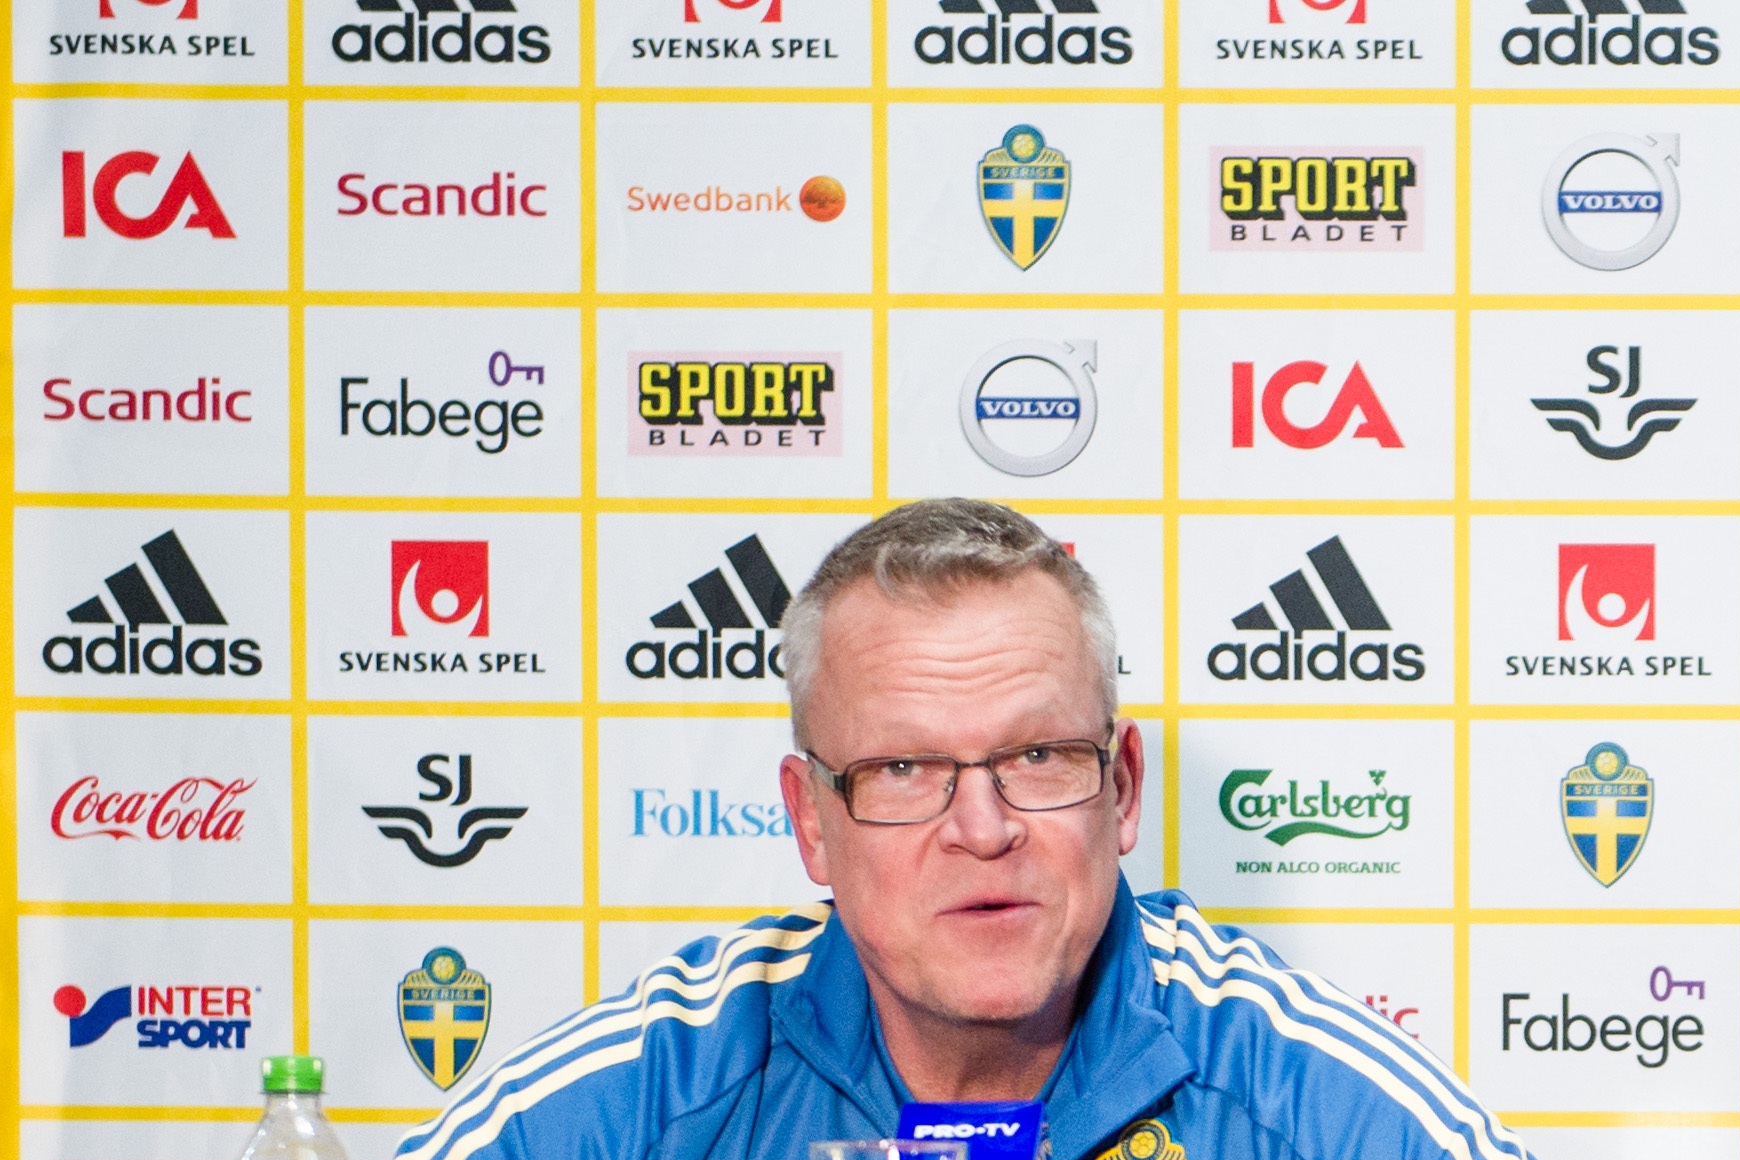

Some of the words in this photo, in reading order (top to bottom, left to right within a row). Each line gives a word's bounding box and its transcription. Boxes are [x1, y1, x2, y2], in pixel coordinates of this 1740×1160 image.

[50, 34, 176, 55] SVENSKA
[188, 36, 254, 56] SPEL
[331, 13, 551, 63] adidas
[633, 38, 760, 58] SVENSKA
[772, 38, 837, 58] SPEL
[914, 15, 1133, 65] adidas
[1217, 39, 1344, 59] SVENSKA
[1357, 39, 1422, 59] SPEL
[1501, 15, 1720, 66] adidas
[62, 151, 236, 239] ICA
[338, 172, 546, 216] Scandic
[628, 186, 791, 212] Swedbank
[1221, 155, 1417, 221] SPORT
[1563, 194, 1659, 210] VOLVO
[1231, 225, 1406, 242] BLADET
[638, 361, 835, 427] SPORT
[1587, 345, 1640, 398] SJ
[43, 378, 251, 422] Scandic
[341, 376, 544, 454] Fabege
[981, 400, 1076, 417] VOLVO
[1232, 361, 1404, 450] ICA
[649, 430, 824, 446] BLADET
[42, 625, 262, 676] adidas
[340, 652, 468, 672] SVENSKA
[479, 653, 544, 672] SPEL
[1207, 631, 1425, 681] adidas
[1506, 656, 1634, 676] SVENSKA
[1645, 656, 1711, 676] SPEL
[417, 754, 472, 806] SJ
[1218, 767, 1412, 833] Carlsberg
[50, 775, 259, 844] Coca-Cola
[630, 787, 795, 839] Folksa
[1236, 861, 1272, 873] NON
[1276, 861, 1320, 874] ALCO
[1324, 862, 1399, 873] ORGANIC
[138, 986, 251, 1016] INTER
[137, 1019, 251, 1049] SPORT
[1503, 993, 1704, 1068] Fabege
